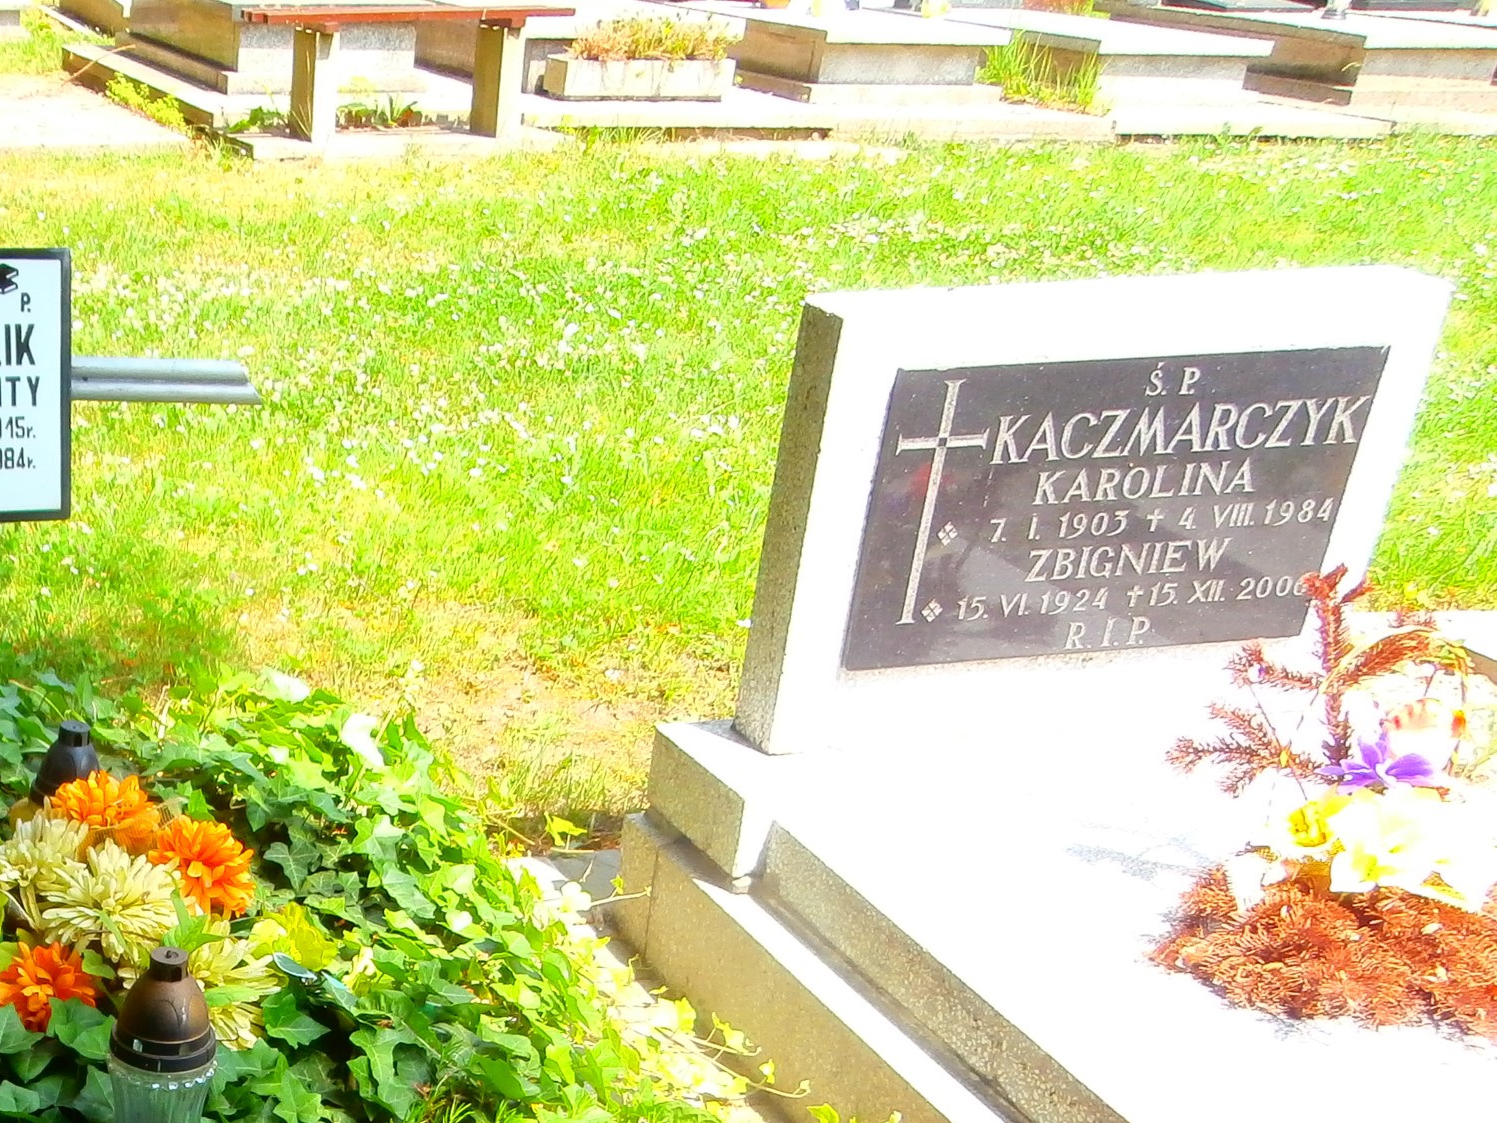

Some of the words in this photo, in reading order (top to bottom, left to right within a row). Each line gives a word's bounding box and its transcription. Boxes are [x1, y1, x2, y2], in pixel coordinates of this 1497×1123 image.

[989, 395, 1372, 465] KACZMARCZYK
[1032, 457, 1255, 505] KAROLINA
[1058, 509, 1130, 540] 1903
[1263, 498, 1335, 526] 1984
[1024, 538, 1233, 583] ZBIGNIEW
[957, 594, 989, 621] 15.
[1000, 592, 1029, 619] VI.
[1040, 586, 1109, 615] 1924
[1149, 581, 1178, 607] 15.
[1187, 579, 1226, 604] XII.
